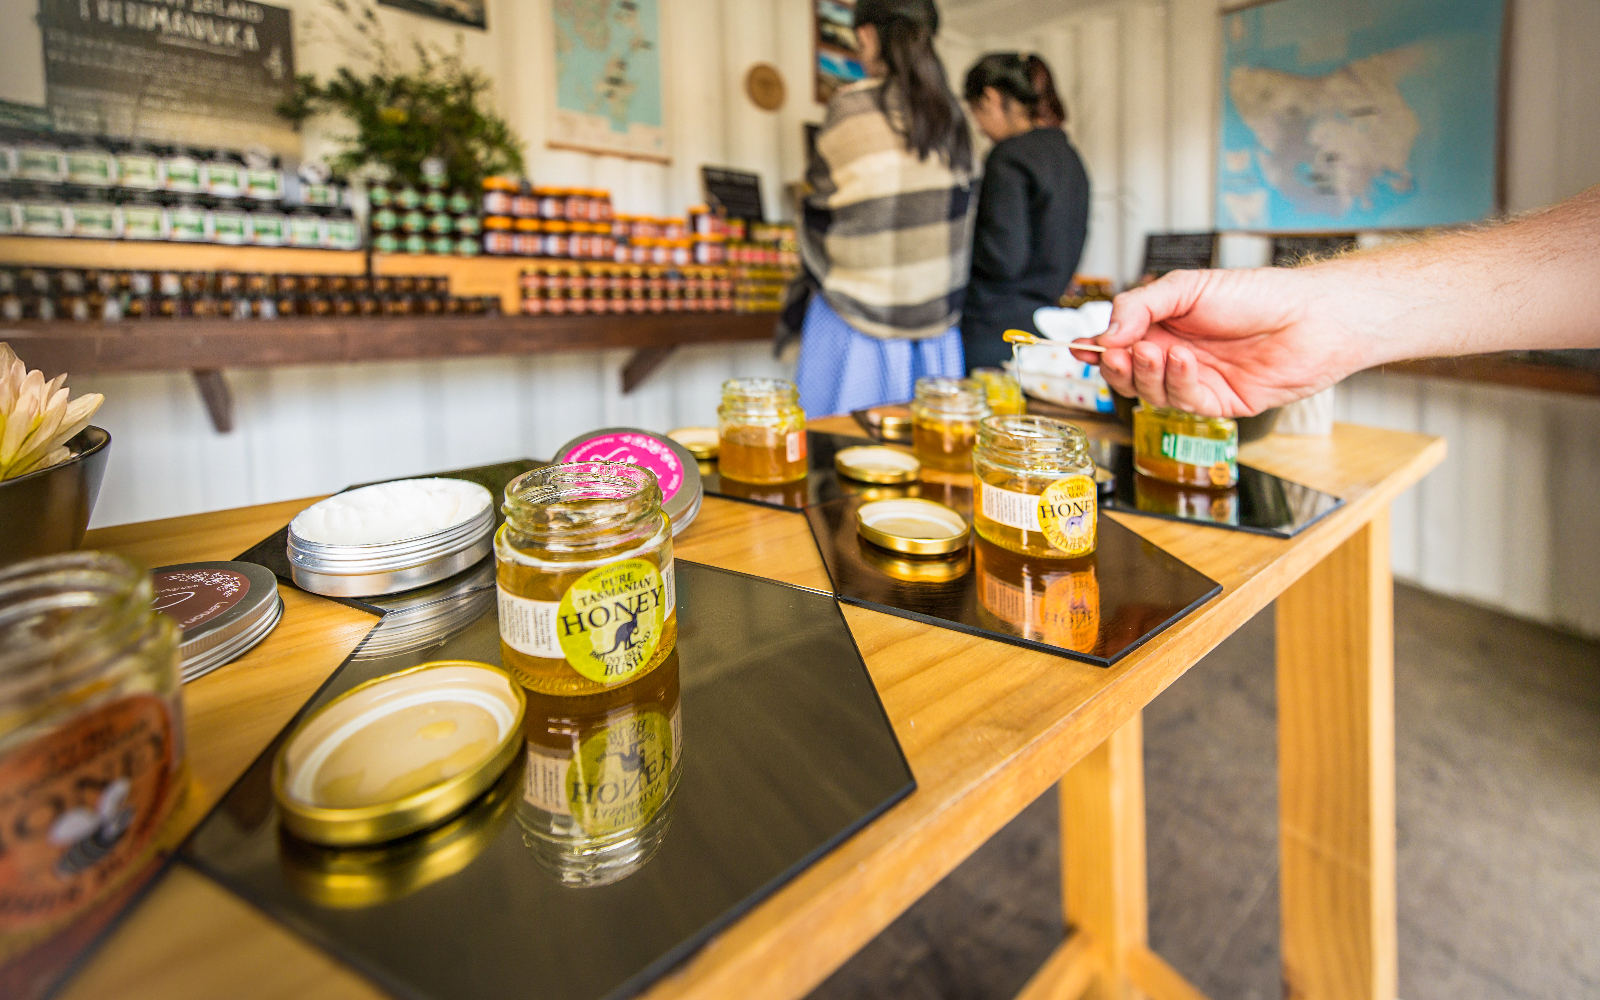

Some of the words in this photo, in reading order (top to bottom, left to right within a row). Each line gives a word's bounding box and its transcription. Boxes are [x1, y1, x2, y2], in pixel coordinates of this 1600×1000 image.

[1066, 485, 1085, 493] PURE
[578, 577, 652, 607] TASMANIAN
[601, 571, 634, 590] PURE
[560, 585, 664, 638] HONEY
[603, 653, 644, 676] BUSH
